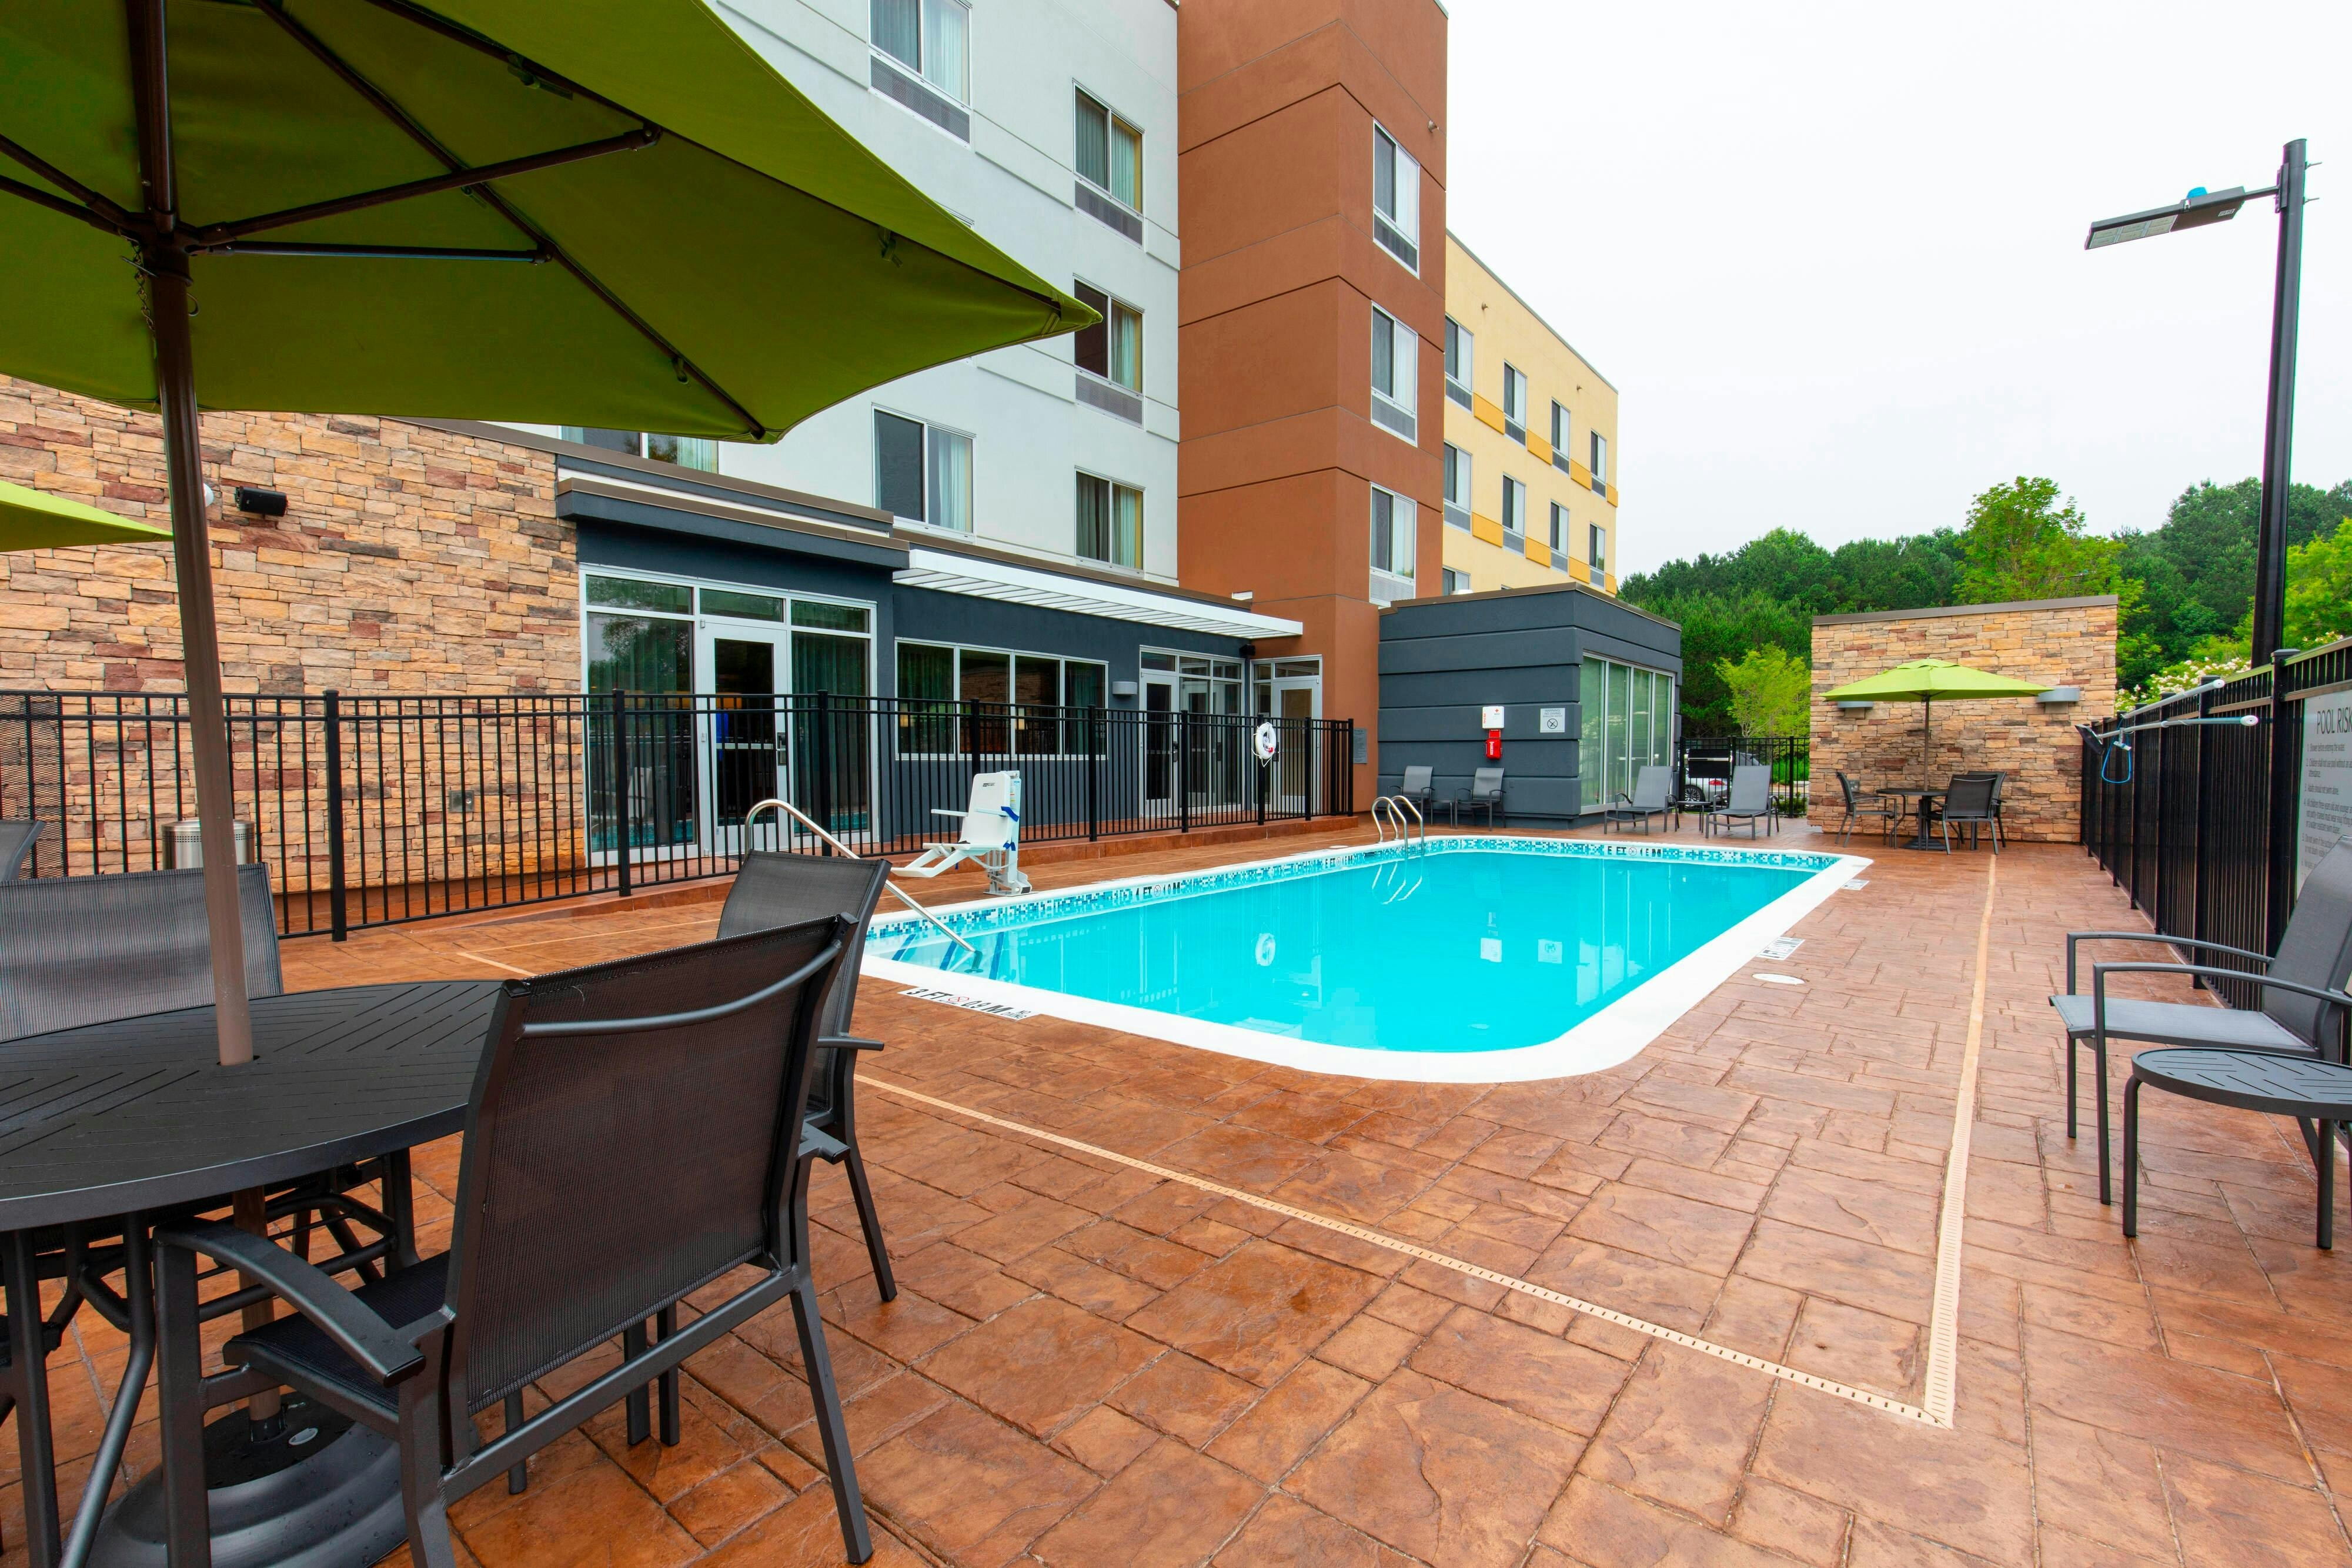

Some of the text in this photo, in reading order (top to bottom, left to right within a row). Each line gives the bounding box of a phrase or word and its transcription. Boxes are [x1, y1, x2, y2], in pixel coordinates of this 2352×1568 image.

[2317, 709, 2334, 734] POOL
[920, 991, 954, 999] FT
[980, 1005, 1014, 1013] M
